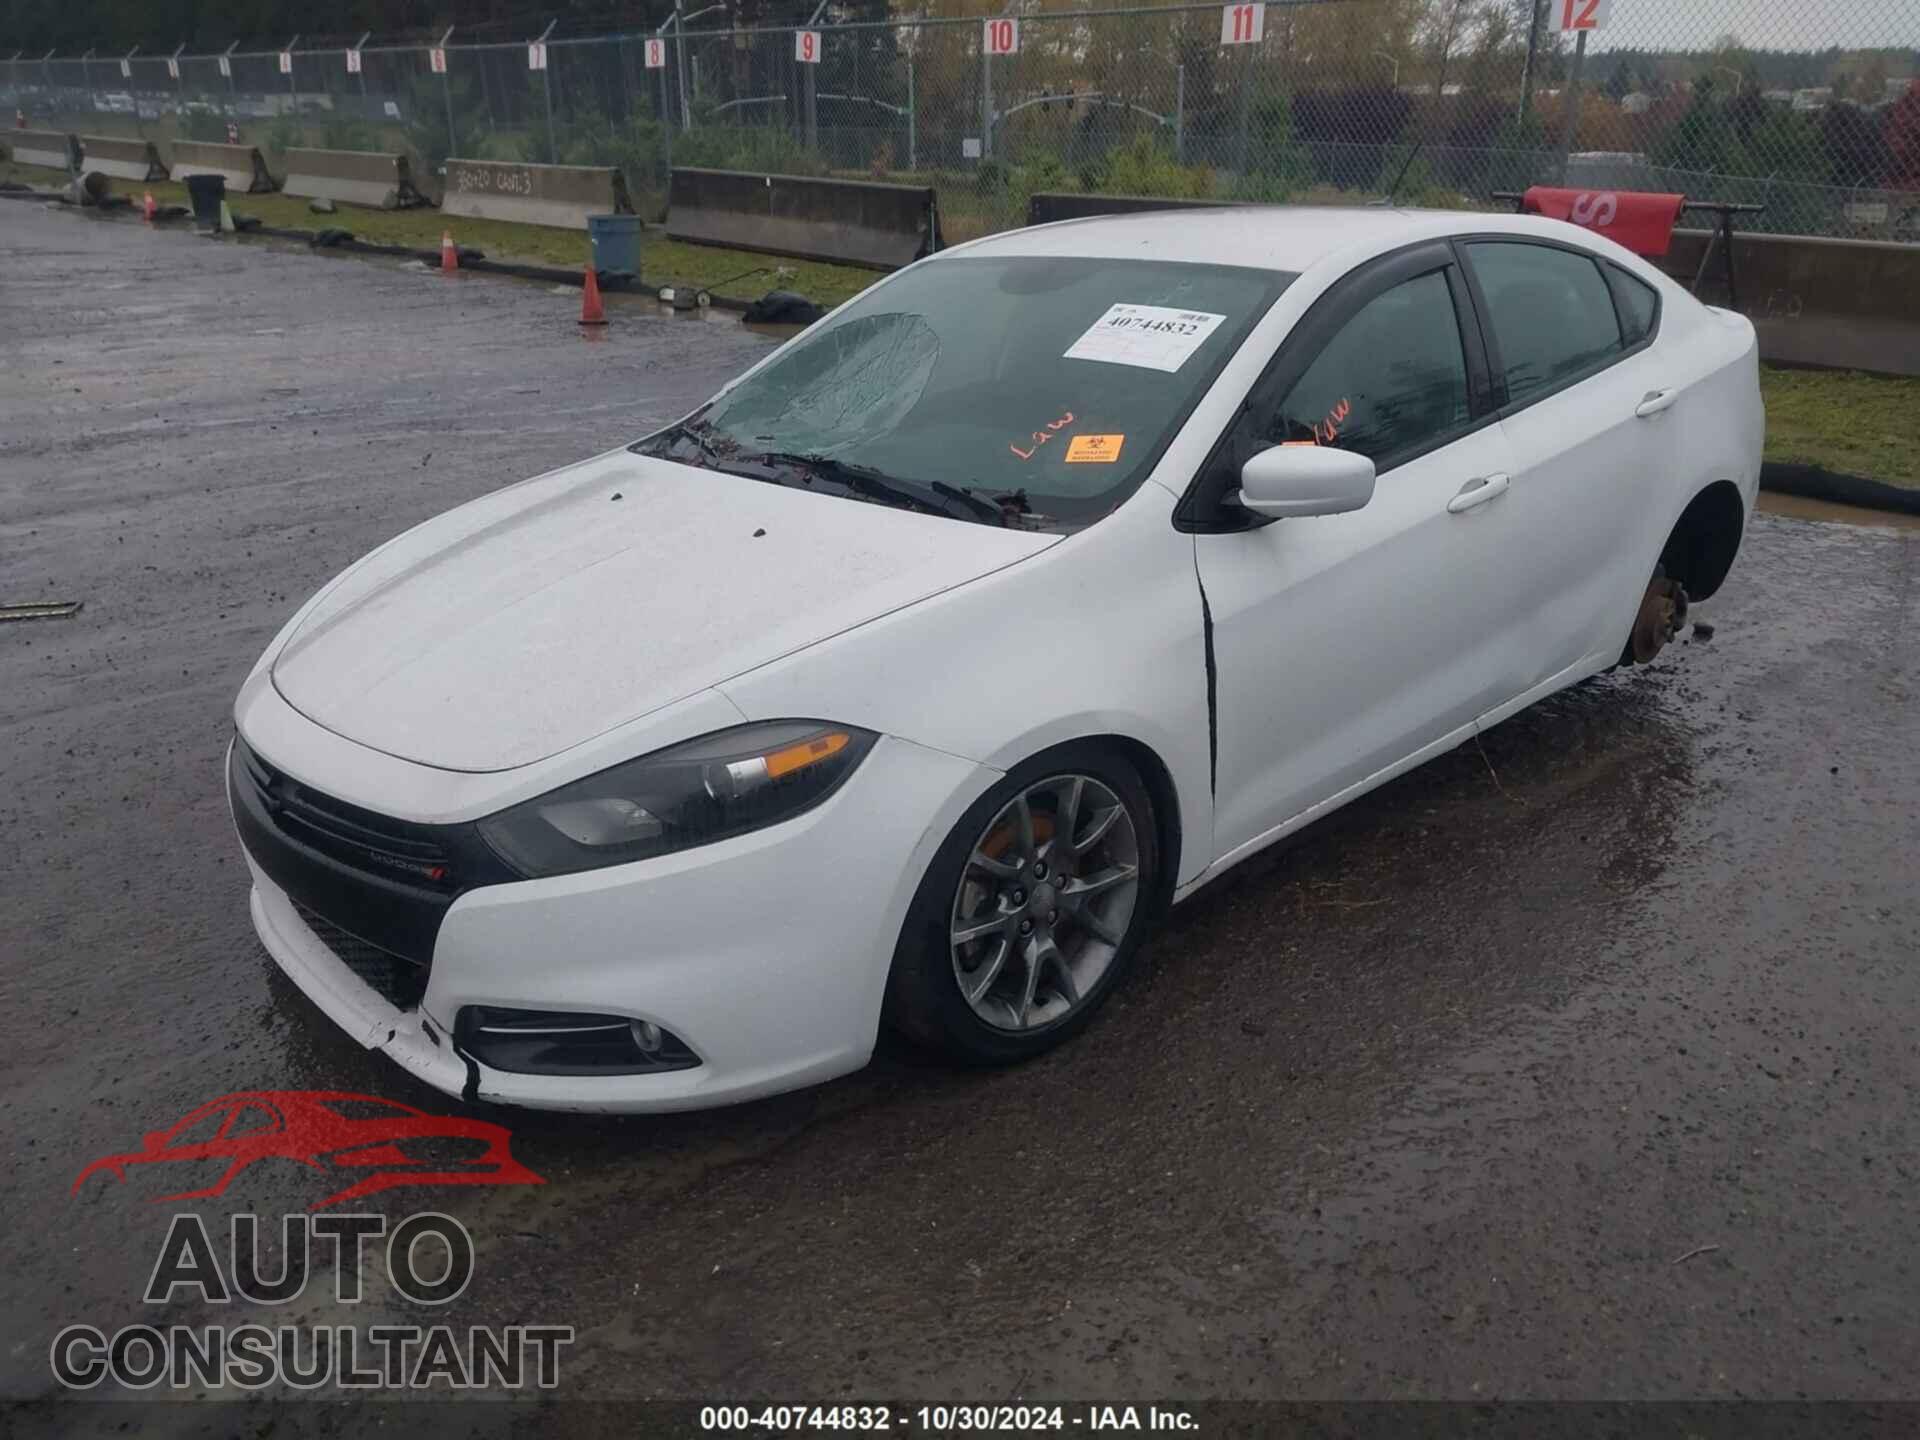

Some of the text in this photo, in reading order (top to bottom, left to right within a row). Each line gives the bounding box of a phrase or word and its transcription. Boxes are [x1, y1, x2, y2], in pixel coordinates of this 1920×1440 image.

[1232, 5, 1254, 41] 11
[1561, 0, 1600, 30] 12
[803, 32, 813, 60] 9
[989, 20, 1013, 52] 10
[651, 41, 659, 65] 8
[1108, 316, 1198, 336] 40744832
